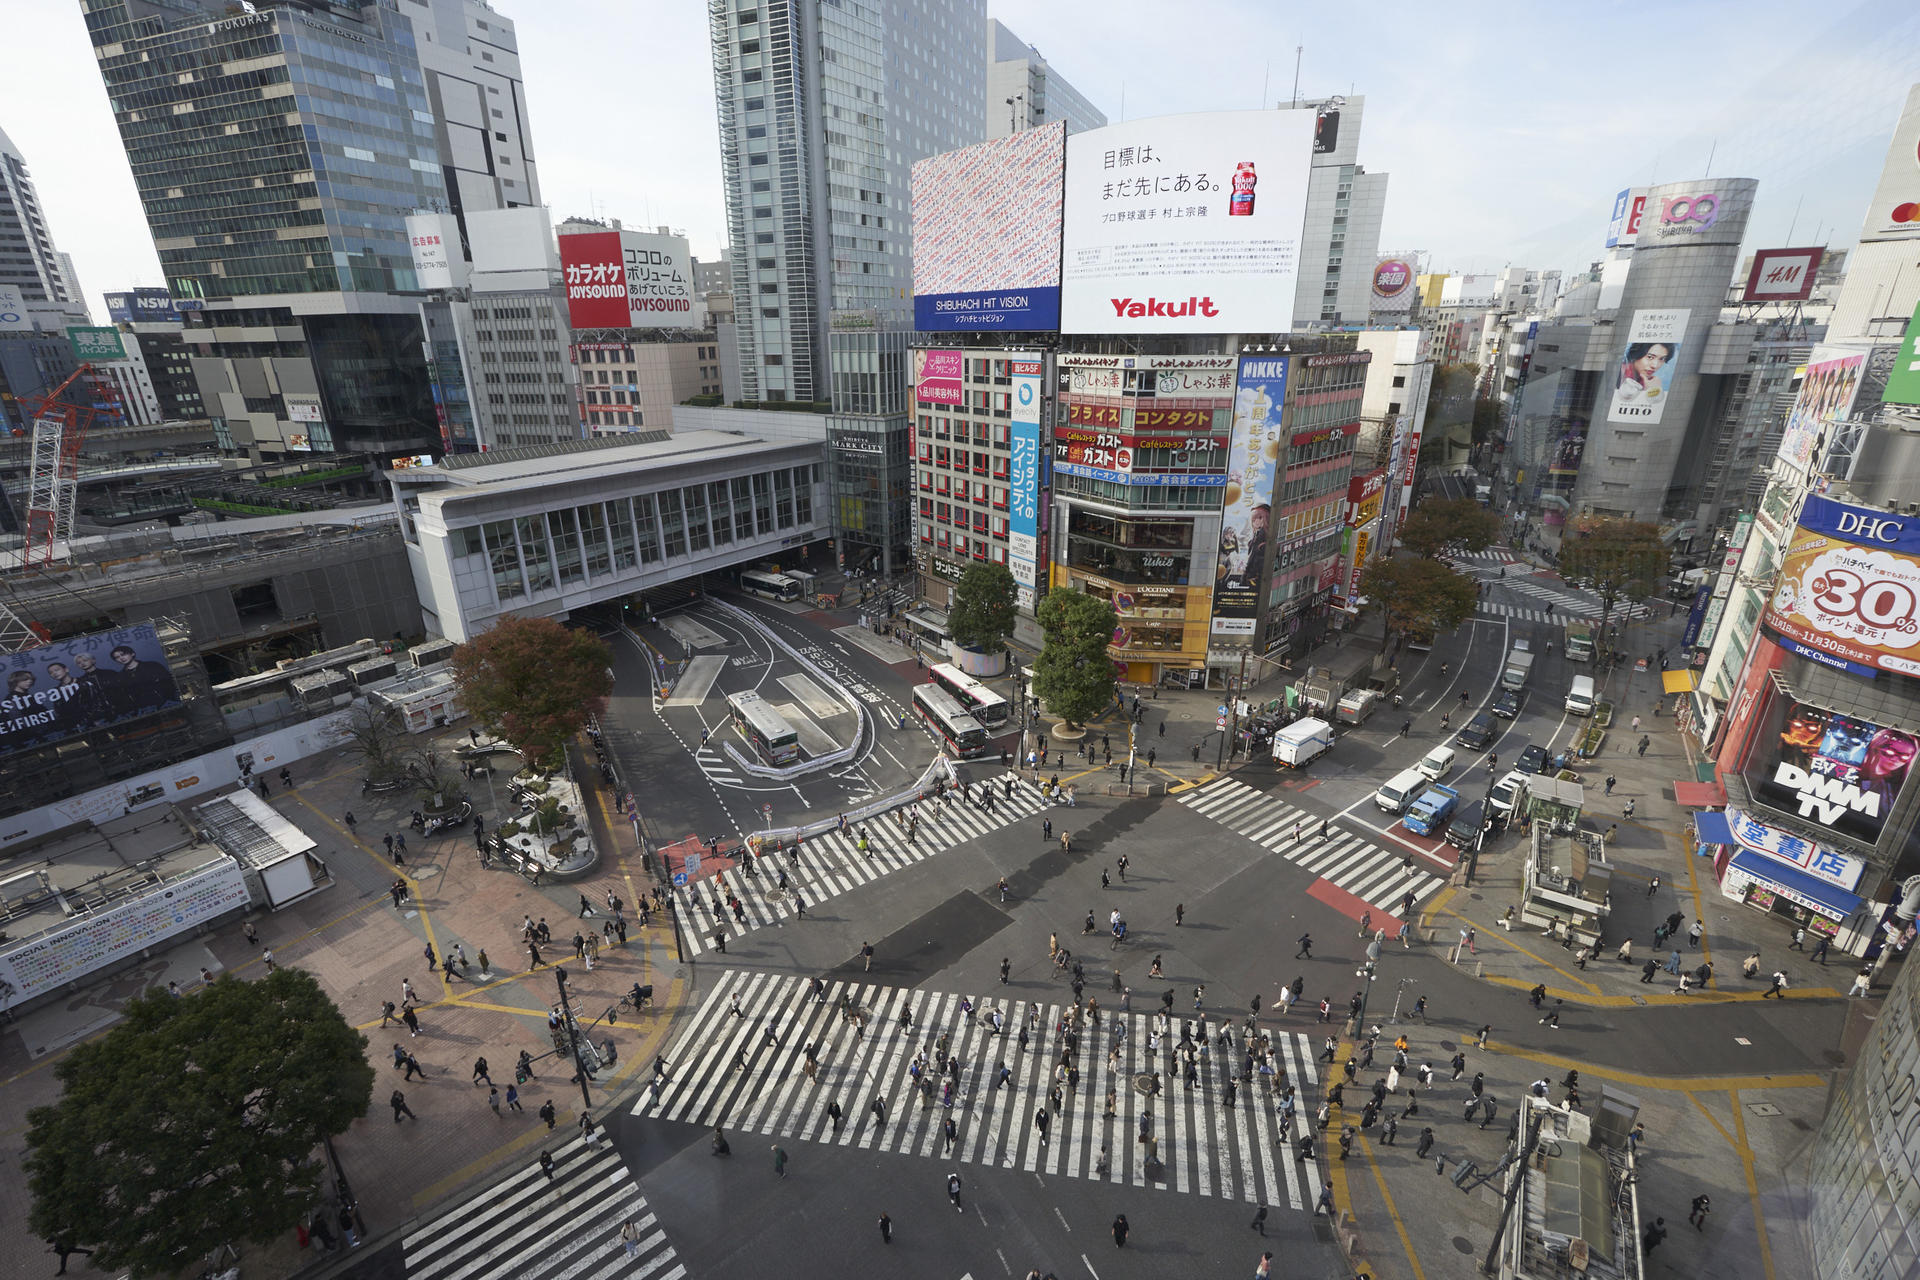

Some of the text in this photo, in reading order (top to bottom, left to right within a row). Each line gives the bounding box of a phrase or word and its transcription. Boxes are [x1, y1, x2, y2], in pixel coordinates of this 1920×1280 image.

[218, 13, 269, 31] FUKURAS
[1104, 145, 1161, 169] 目標は、
[1102, 173, 1220, 200] まだ先にある。
[1102, 208, 1157, 224] プロ野球選手
[1660, 193, 1720, 233] 109
[624, 249, 672, 266] ココロの
[566, 263, 621, 284] カラオケ
[627, 266, 687, 283] ボリューム、
[1765, 265, 1802, 283] H&M
[569, 285, 625, 299] JOYSOUND
[630, 283, 689, 297] あげていこう。
[107, 298, 125, 309] NSW
[137, 298, 169, 308] NSW
[630, 298, 690, 312] JOYSOUND
[936, 296, 1028, 311] SHIBUHACHI HIT VISION
[1111, 297, 1220, 318] Yakult
[74, 331, 117, 346] 東進
[935, 355, 960, 365] 品川スキン
[1151, 358, 1233, 368] しゃぶしゃぶバイキング
[935, 365, 958, 374] クリニック
[1243, 361, 1284, 379] NIKKE
[1060, 374, 1070, 384] 9F
[1088, 371, 1120, 388] しゃぶ葉
[1183, 373, 1232, 389] しゃぶ葉
[923, 386, 960, 400] 品川美容外科
[1136, 411, 1210, 426] コンタクト
[1618, 407, 1652, 416] uno
[832, 440, 884, 451] MARK CITY
[1097, 434, 1122, 448] ガスト
[1185, 439, 1220, 451] ガスト
[1057, 445, 1068, 456] 7F
[1083, 448, 1114, 466] ガスト
[1013, 436, 1026, 517] アイシティ
[1026, 438, 1035, 519] コンタクトの
[1073, 465, 1116, 480] 英会話イーオン
[1161, 475, 1225, 485] 英会話イーオン
[1837, 511, 1903, 543] DHC
[1795, 645, 1848, 670] DHC Channel
[1774, 761, 1881, 818] DMM
[1796, 791, 1848, 826] TV
[8, 945, 47, 963] SOCIAL
[50, 918, 110, 945] INNOVATION
[22, 964, 72, 989] HACHIKO
[107, 922, 173, 952] ANNIVERSARY
